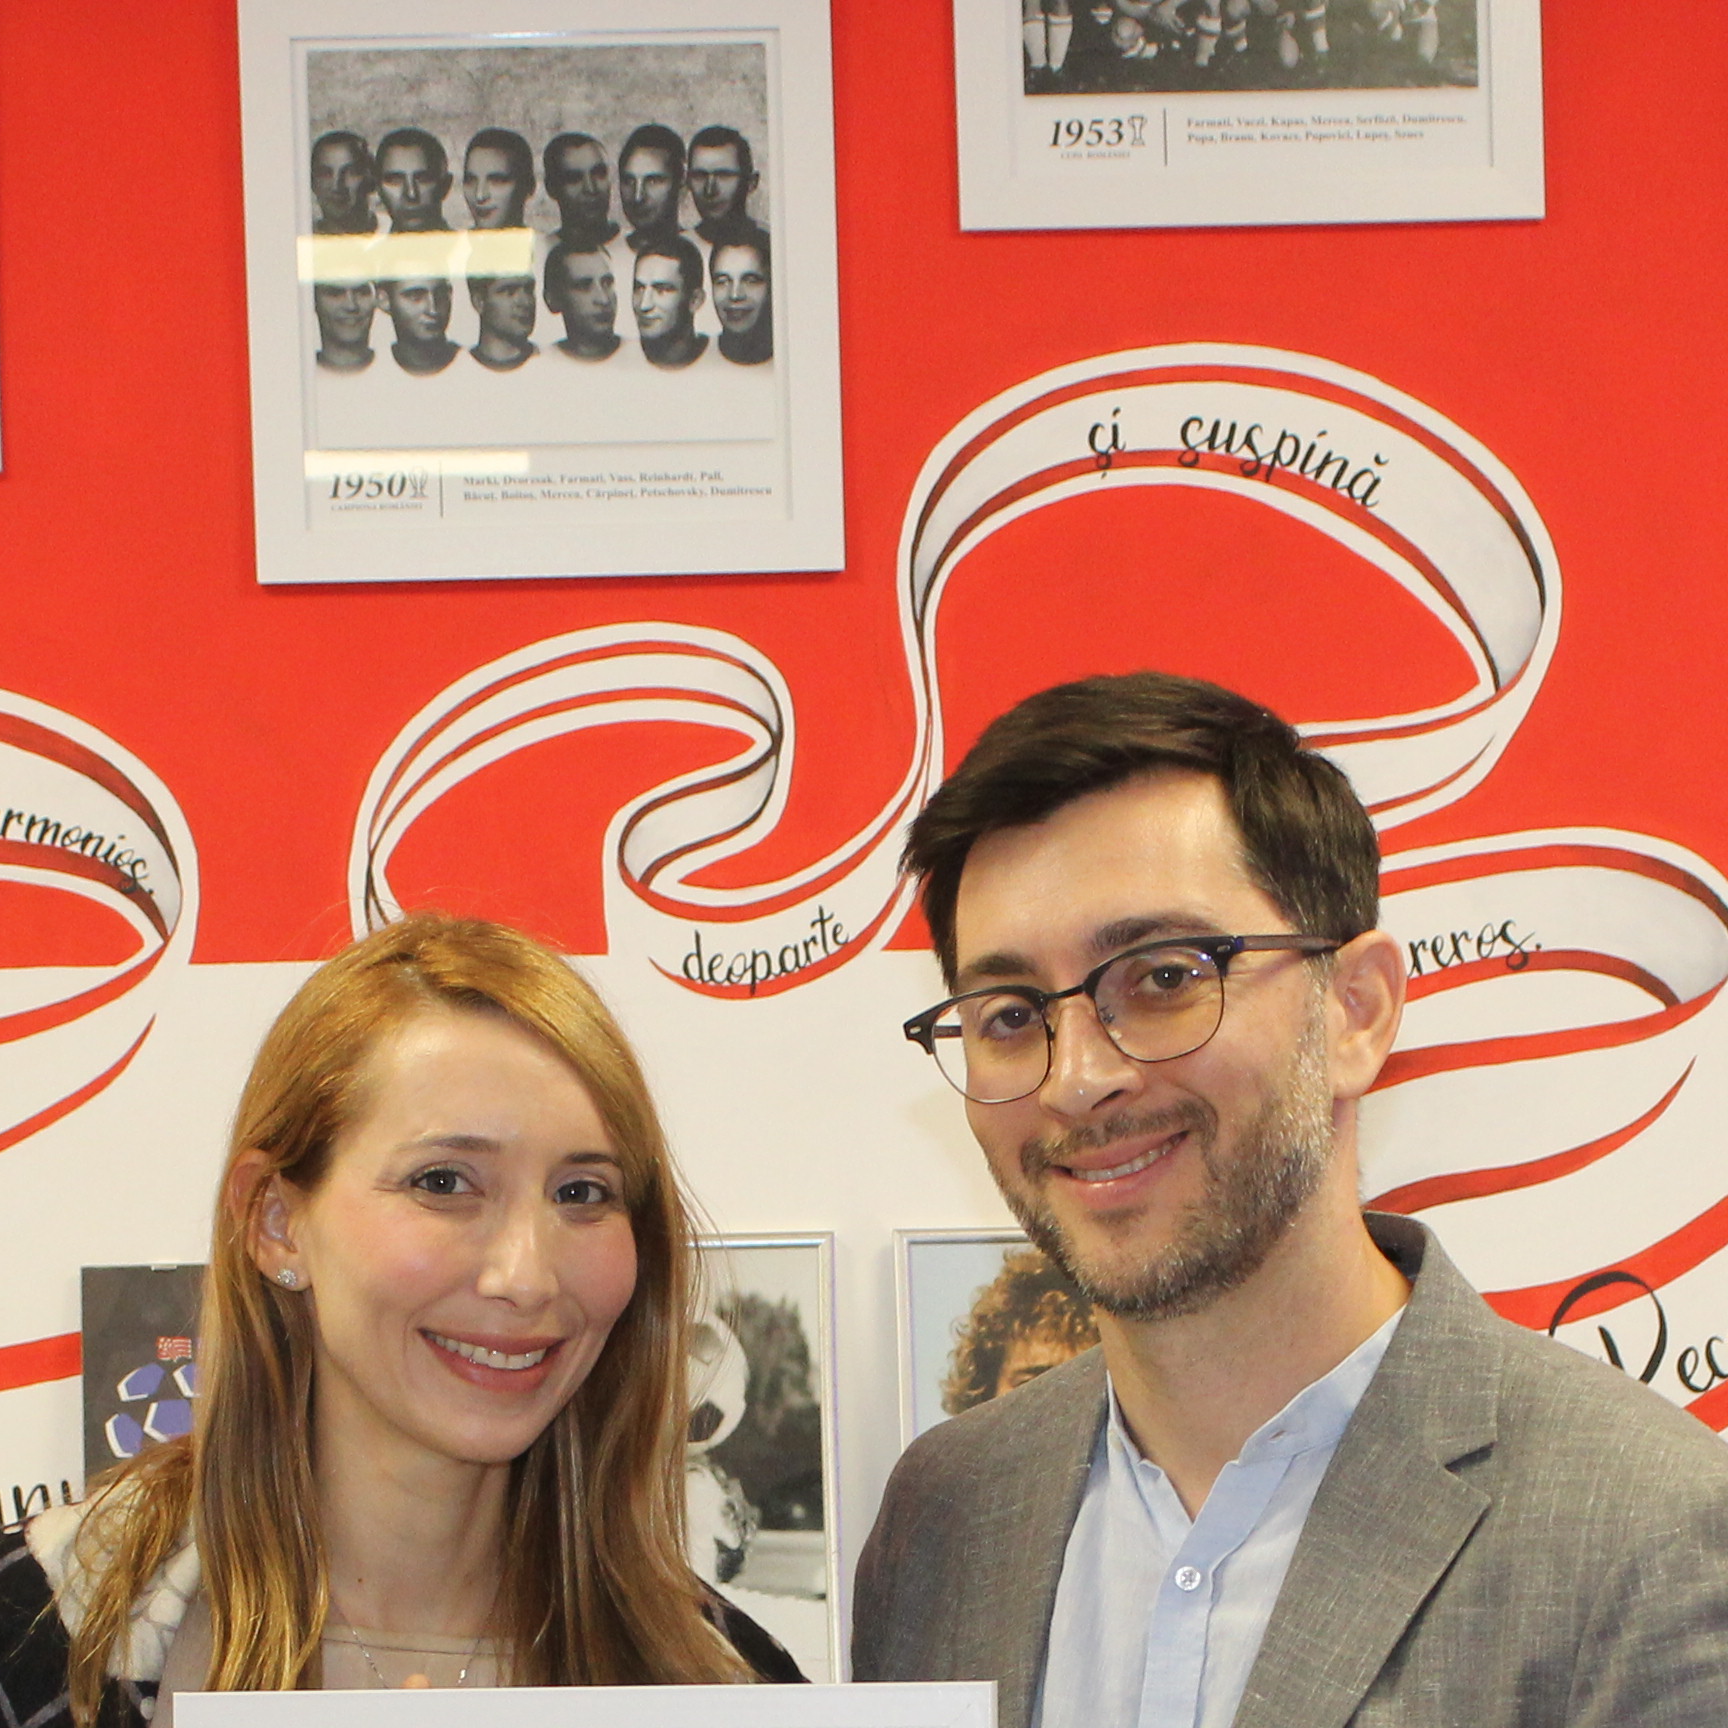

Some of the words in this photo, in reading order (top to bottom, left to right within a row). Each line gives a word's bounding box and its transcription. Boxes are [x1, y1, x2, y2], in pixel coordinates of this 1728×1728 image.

[1050, 118, 1125, 147] 1953
[329, 471, 407, 499] 1950
[681, 905, 855, 996] deoparte
[1406, 919, 1543, 970] reros.
